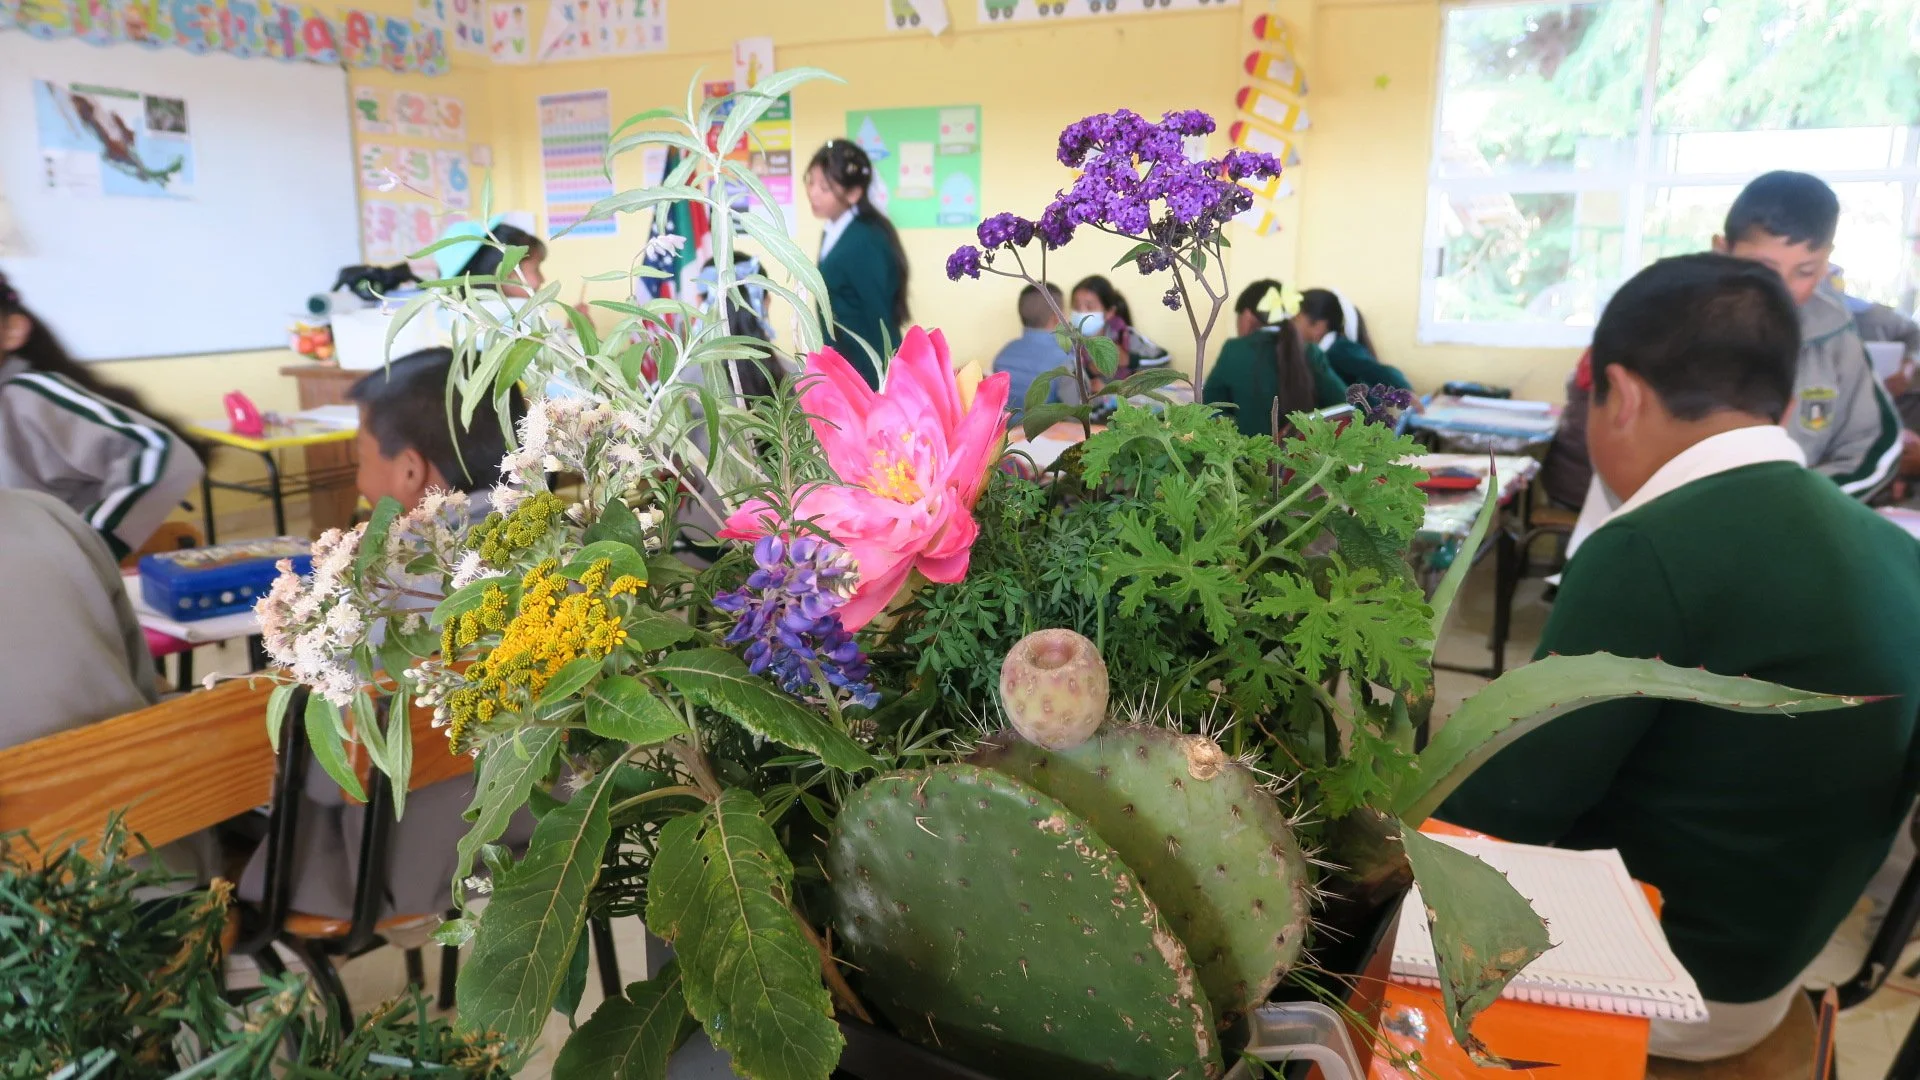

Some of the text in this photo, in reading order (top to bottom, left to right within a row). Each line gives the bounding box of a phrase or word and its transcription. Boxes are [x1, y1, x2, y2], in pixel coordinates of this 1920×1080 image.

[407, 96, 426, 125] 2
[445, 101, 463, 129] 3
[448, 157, 468, 191] 6
